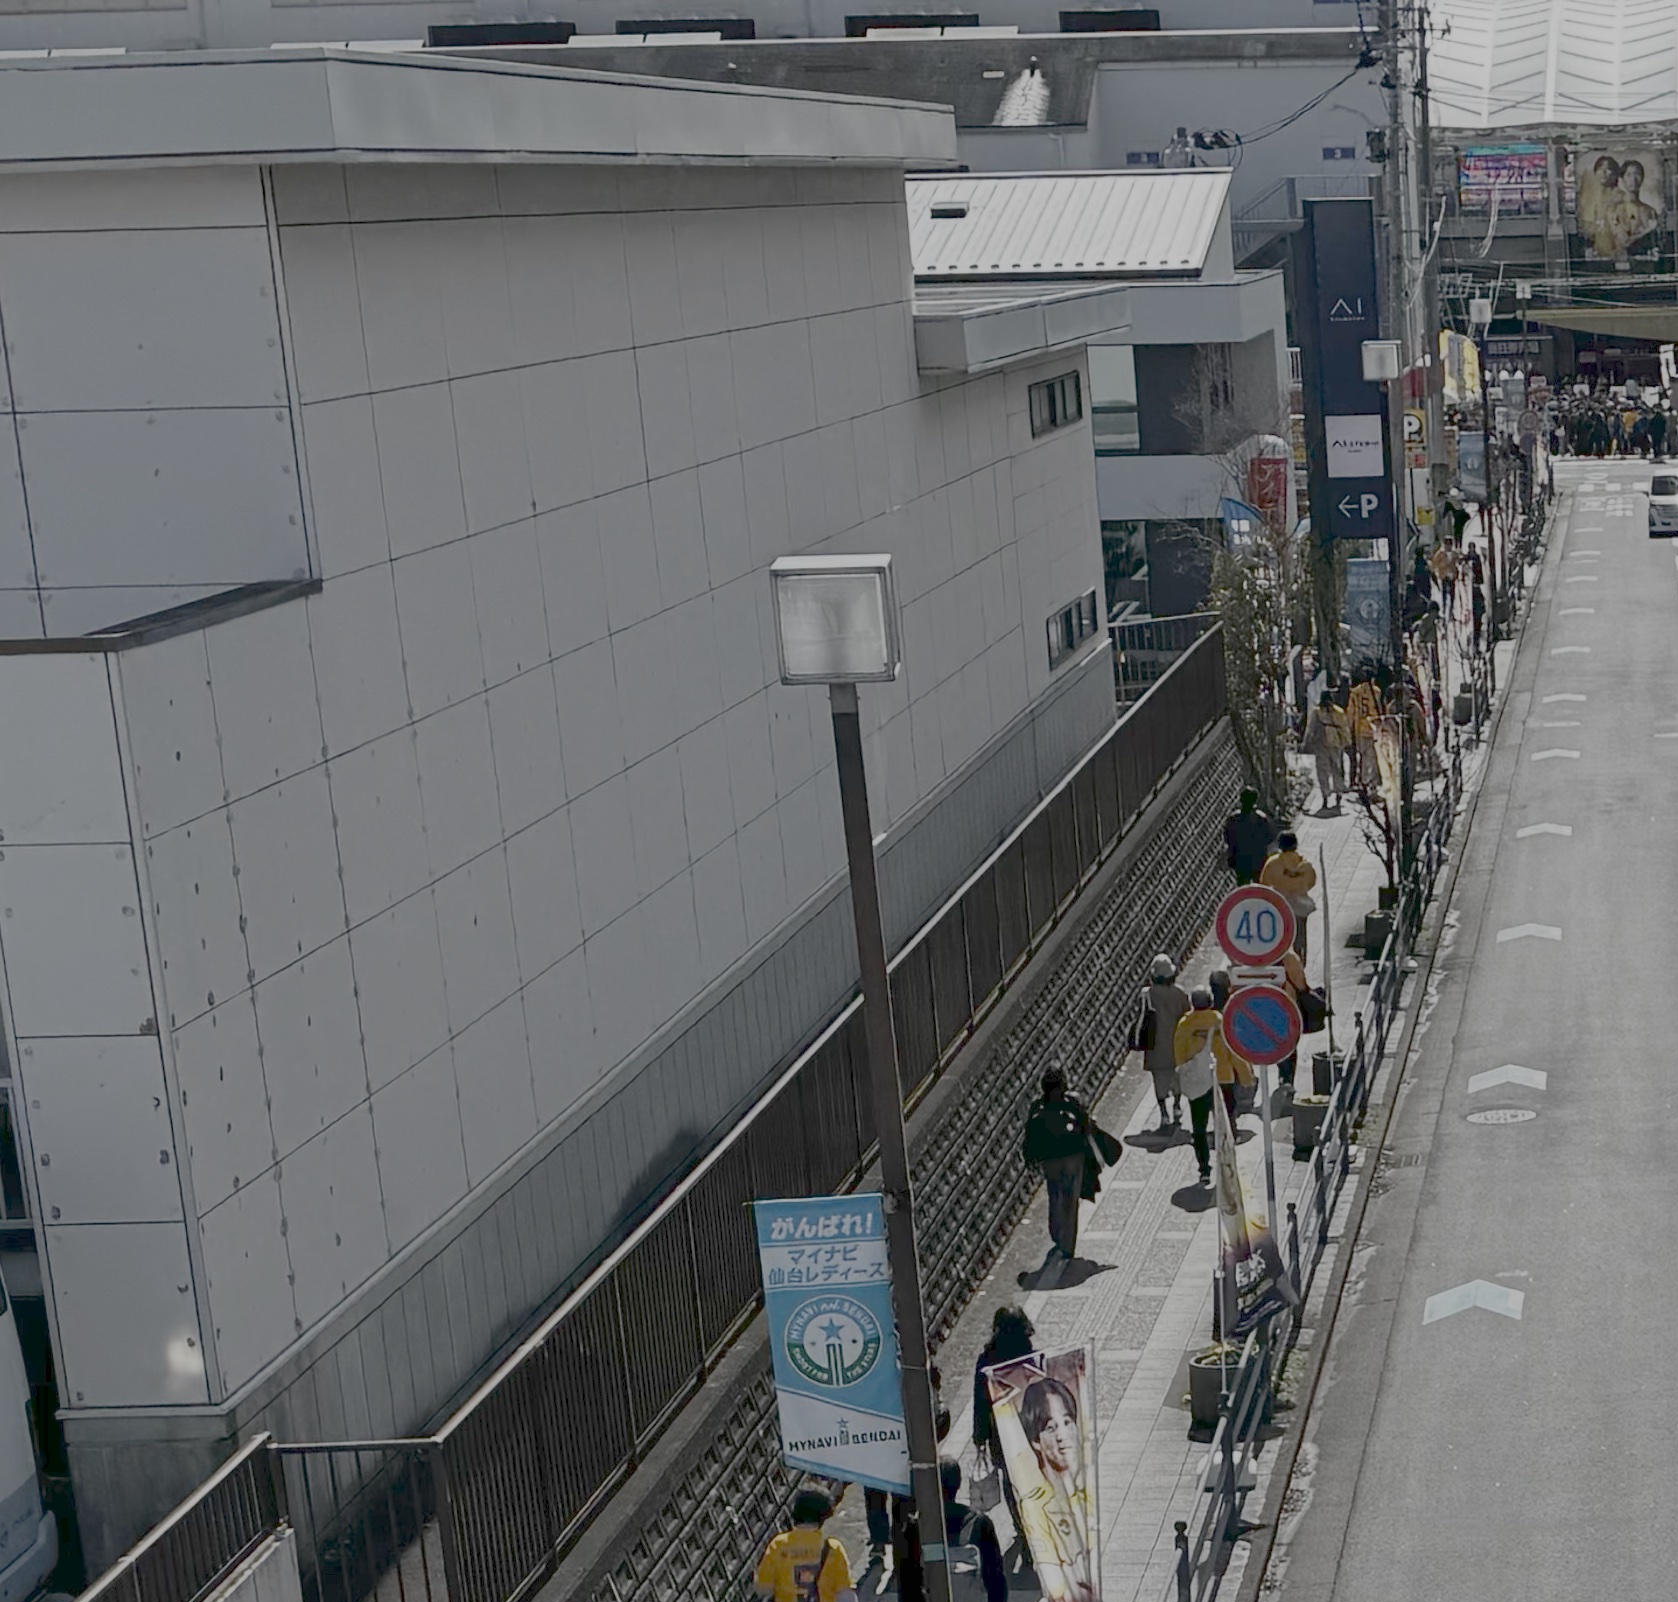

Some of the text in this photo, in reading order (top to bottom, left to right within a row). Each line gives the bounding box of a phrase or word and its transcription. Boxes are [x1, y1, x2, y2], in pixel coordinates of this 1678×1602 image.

[1360, 494, 1379, 518] P
[1235, 909, 1277, 944] 40
[788, 1244, 860, 1265] マイナビ
[768, 1262, 884, 1285] 仙台レディース
[788, 1435, 838, 1452] MYNAVI
